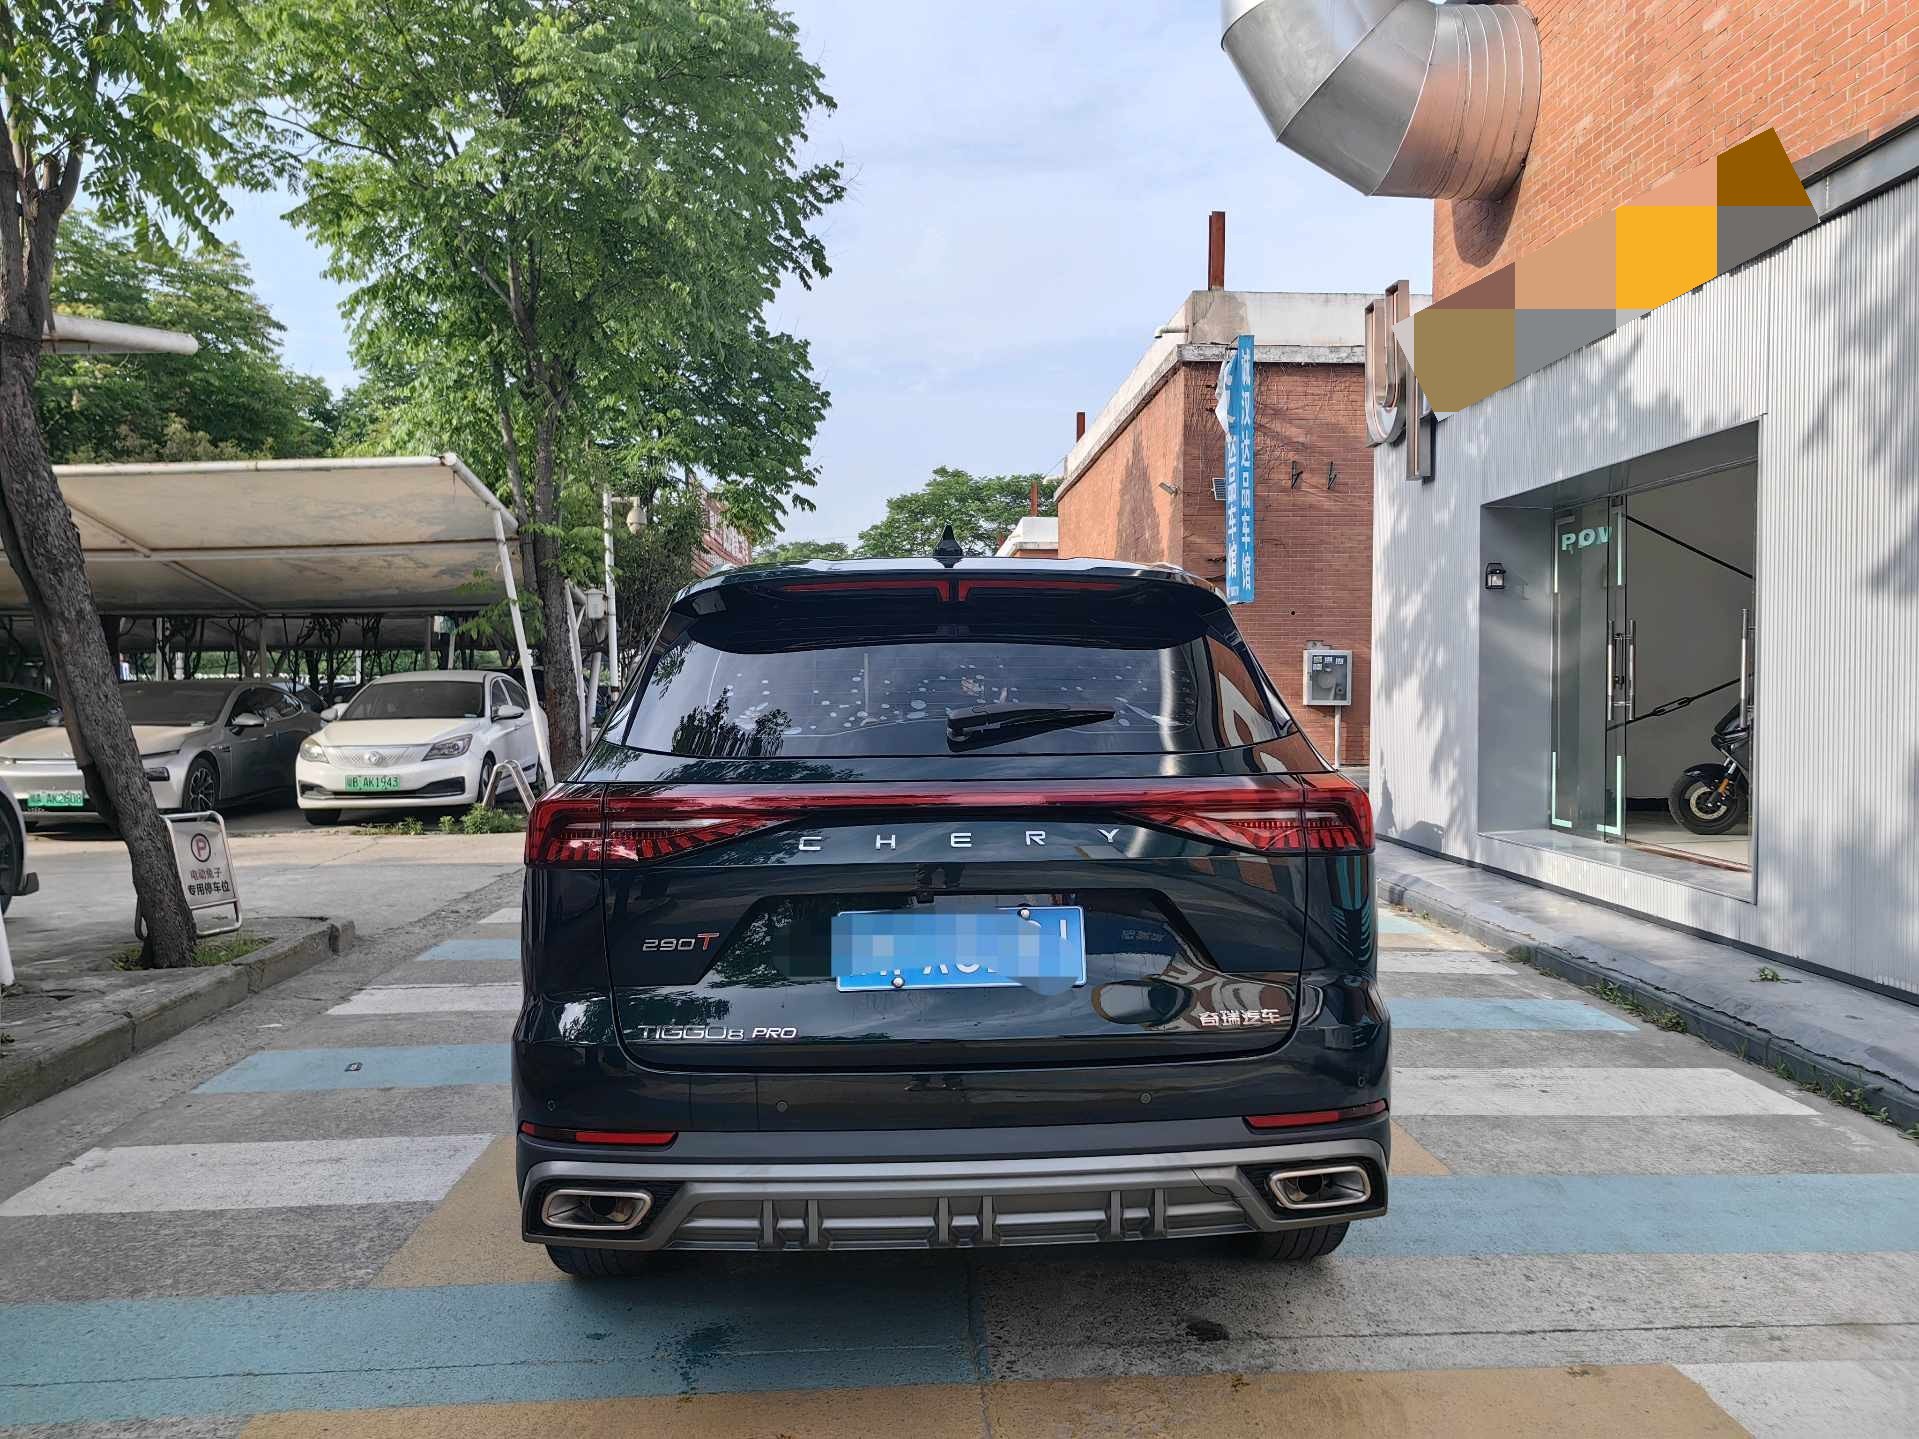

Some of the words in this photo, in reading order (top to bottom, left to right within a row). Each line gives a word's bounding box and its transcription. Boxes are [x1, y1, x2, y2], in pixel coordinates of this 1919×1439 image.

[798, 827, 1120, 852] CHERY
[188, 880, 231, 896] 专用停车位
[642, 931, 720, 953] 290T
[1198, 1008, 1281, 1026] 奇瑞汽车
[751, 1027, 797, 1039] PRO
